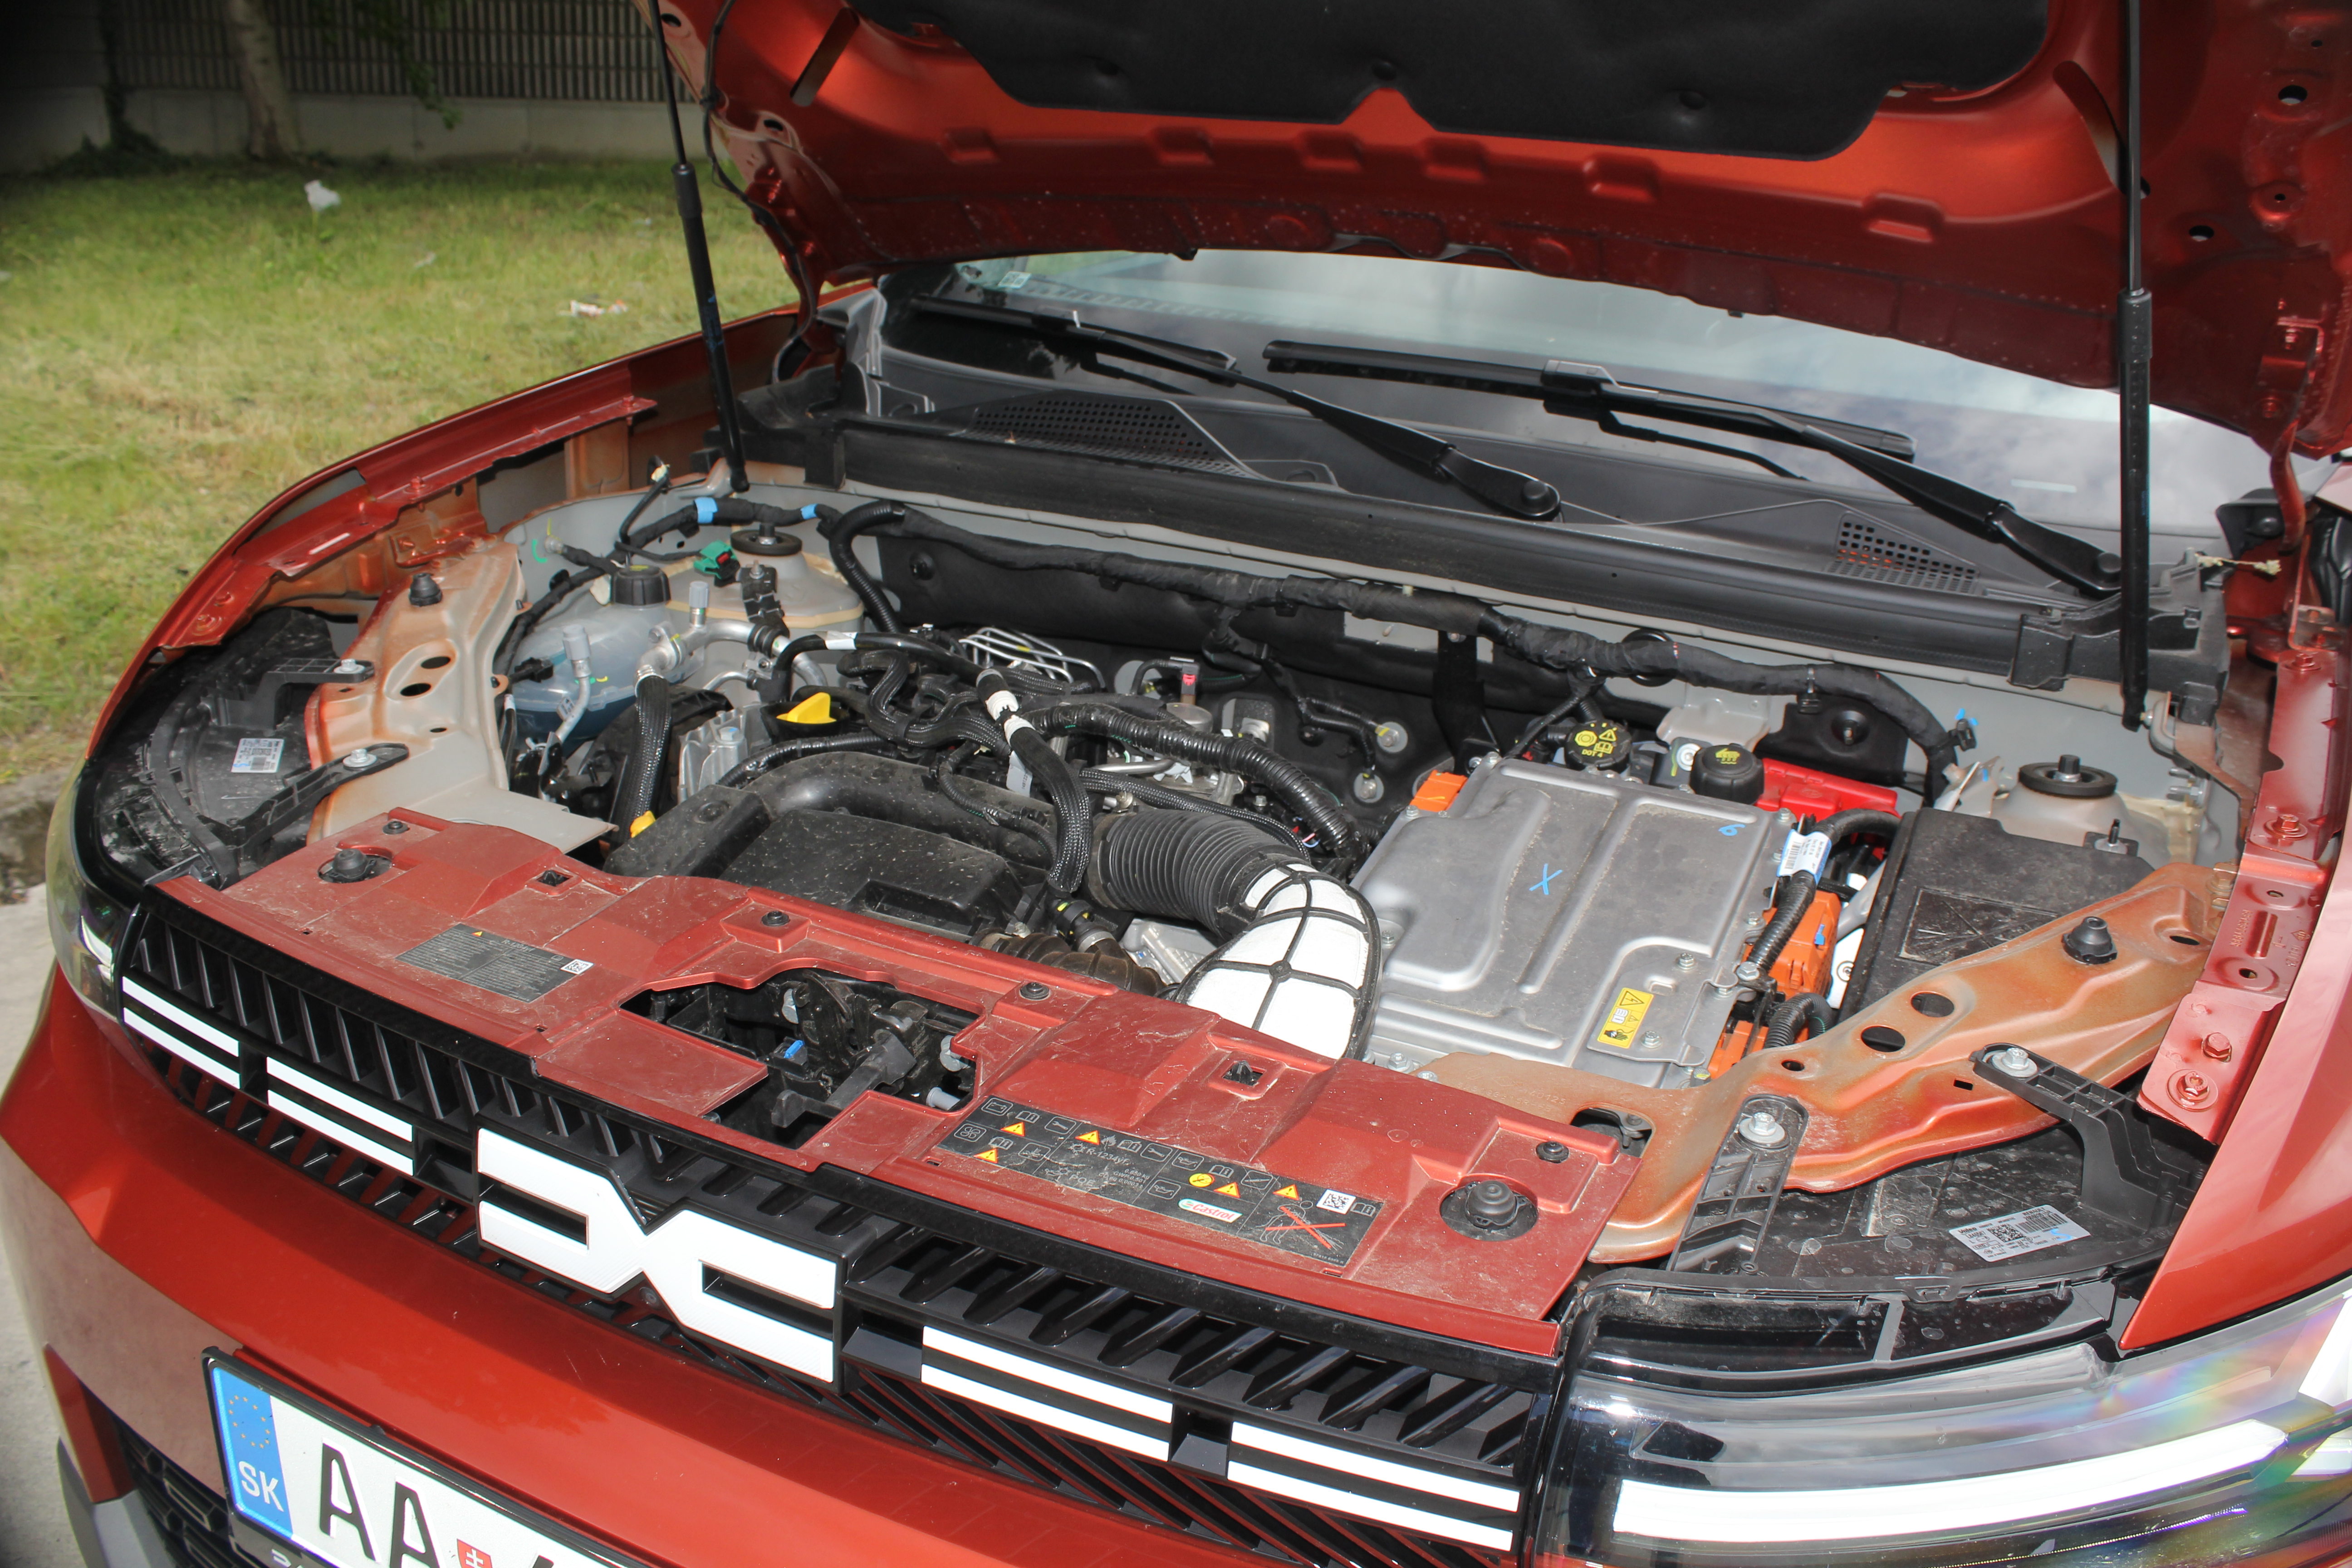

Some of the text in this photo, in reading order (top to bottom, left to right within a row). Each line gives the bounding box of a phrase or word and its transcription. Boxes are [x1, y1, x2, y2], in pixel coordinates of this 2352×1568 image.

[1068, 1174, 1096, 1187] POE
[1192, 1204, 1235, 1220] Castrol
[2022, 1207, 2046, 1215] RENAULT
[239, 1460, 284, 1512] SK
[319, 1442, 440, 1568] AA
